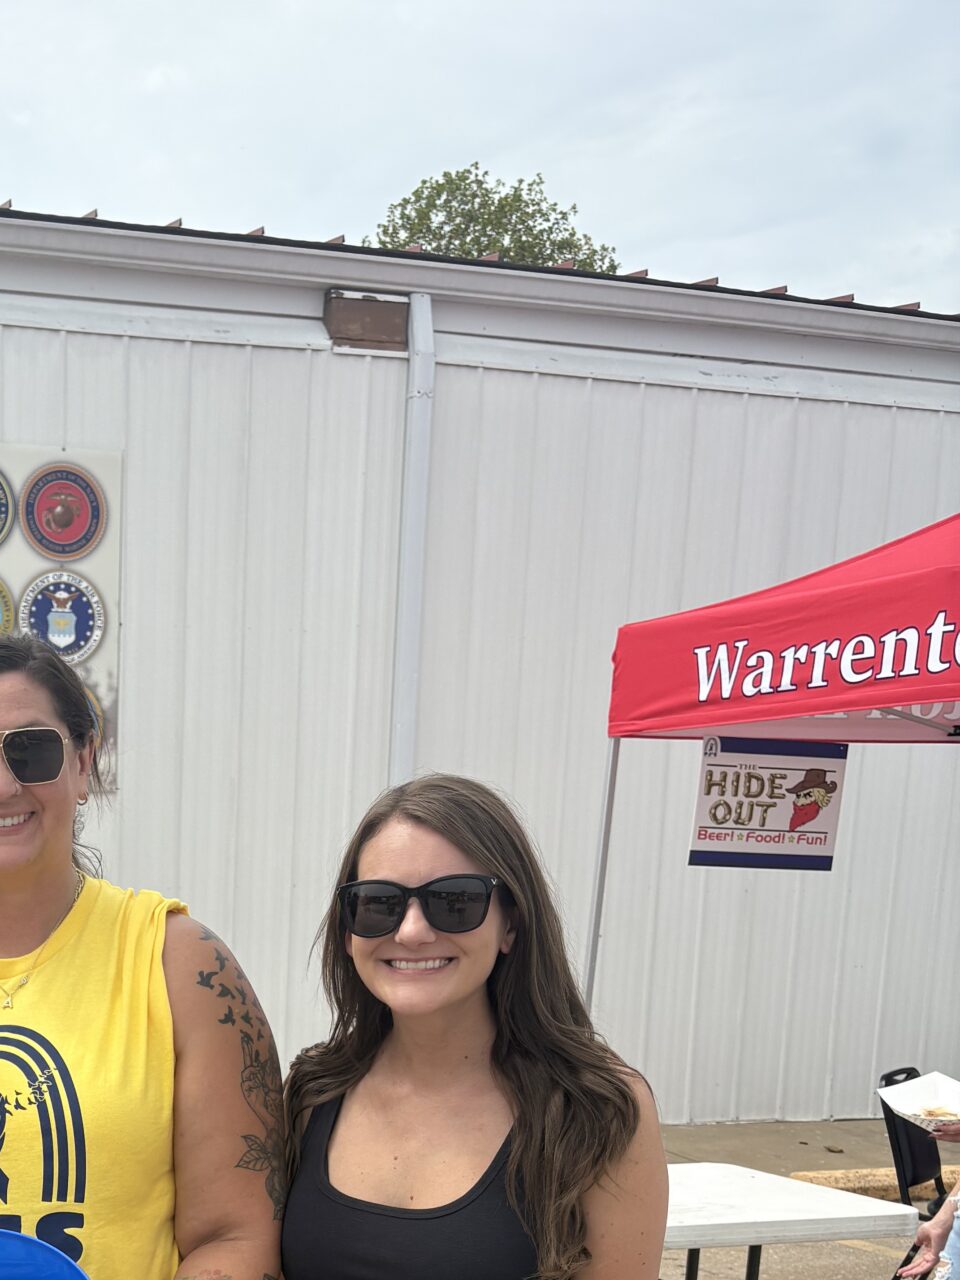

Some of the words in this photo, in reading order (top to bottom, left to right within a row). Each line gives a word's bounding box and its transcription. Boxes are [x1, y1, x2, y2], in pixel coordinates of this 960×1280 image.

[693, 610, 960, 702] Warrent
[738, 763, 758, 771] THE
[704, 769, 787, 800] HIDE
[708, 799, 777, 828] OUT
[697, 829, 734, 842] Beer!
[745, 831, 785, 845] Food!
[797, 834, 827, 846] Fun!
